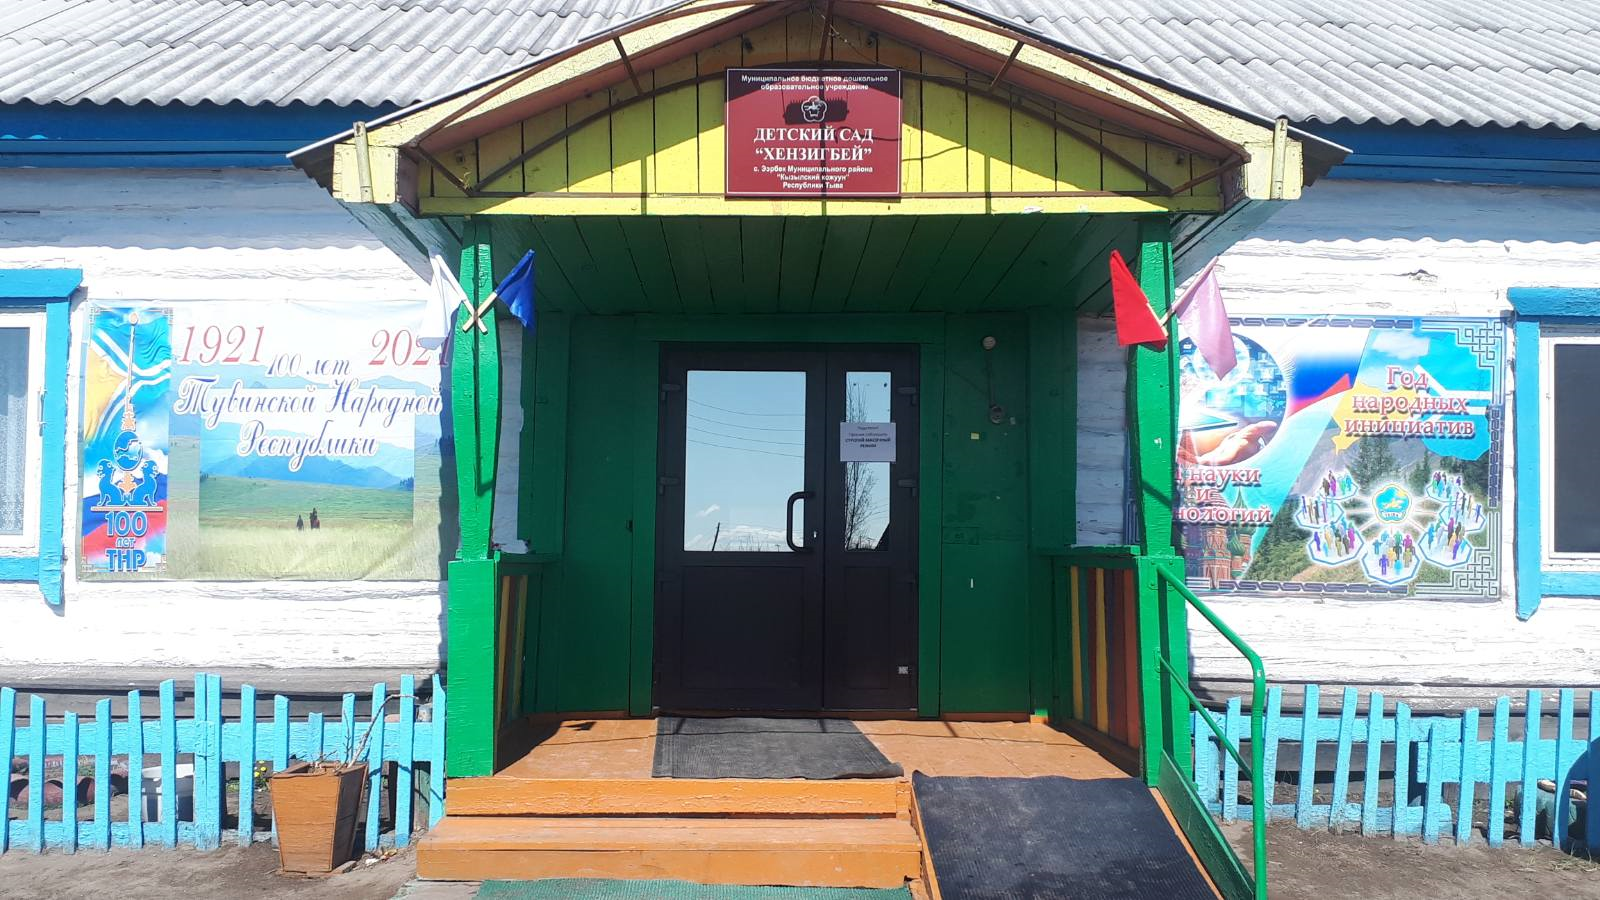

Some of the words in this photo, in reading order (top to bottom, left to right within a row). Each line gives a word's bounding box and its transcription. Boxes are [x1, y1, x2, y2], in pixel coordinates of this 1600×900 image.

[741, 74, 800, 83] Муниципальное
[843, 75, 889, 83] дошкольное
[760, 83, 824, 91] образовательное
[825, 83, 869, 92] учреждение
[753, 125, 836, 143] ДЕТСКИЙ
[839, 127, 874, 143] САД
[787, 165, 847, 173] Муниципального
[847, 165, 873, 173] района
[782, 181, 824, 190] Республики
[825, 181, 844, 189] Тыва
[179, 325, 265, 364] 1921
[266, 354, 302, 377] 100
[306, 359, 351, 376] лет
[1387, 366, 1429, 388] Год
[175, 377, 316, 428] Тувинской
[326, 378, 442, 428] Народной
[1352, 395, 1468, 416] народных
[1344, 419, 1475, 439] инициатив
[239, 419, 378, 472] Республики
[1189, 468, 1261, 488] науки
[1174, 505, 1272, 522] нологий
[105, 511, 148, 537] 100
[115, 537, 137, 548] лет
[106, 549, 147, 571] ТНР
